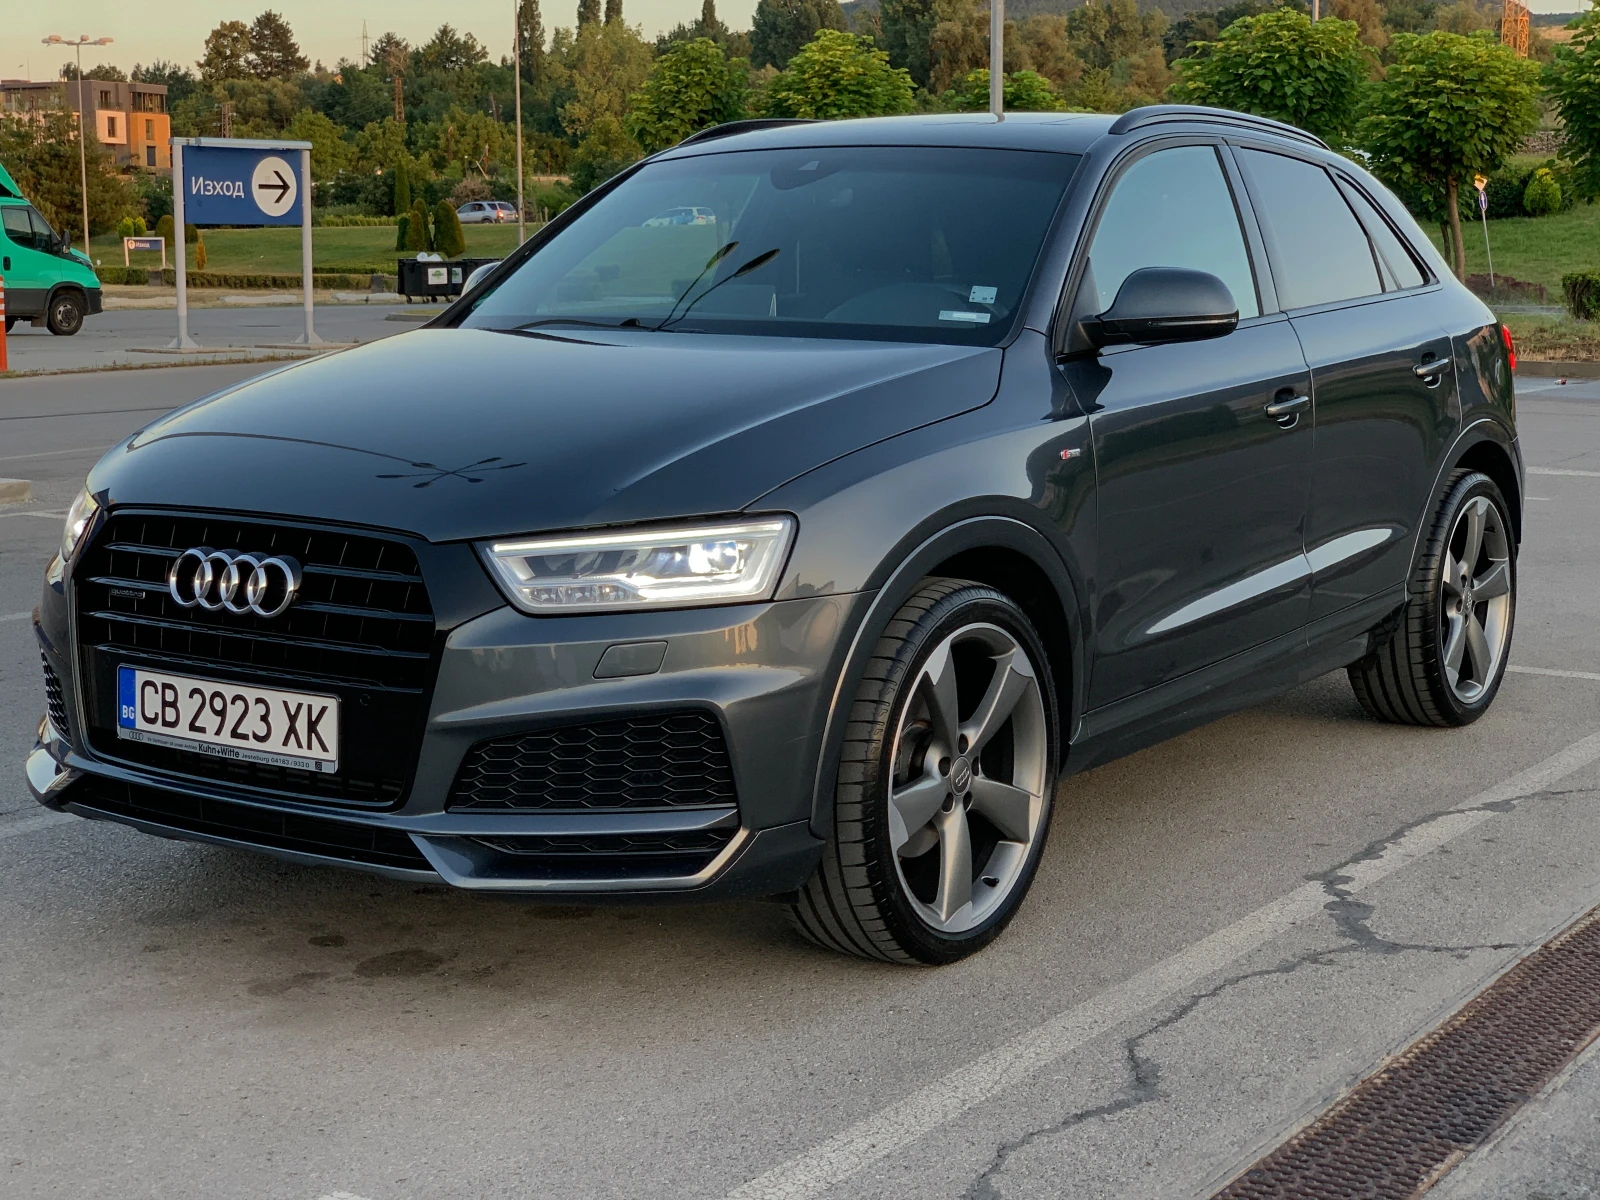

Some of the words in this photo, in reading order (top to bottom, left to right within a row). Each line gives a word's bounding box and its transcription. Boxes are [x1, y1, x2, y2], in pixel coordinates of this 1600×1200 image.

[192, 176, 245, 199] Изход
[122, 705, 135, 719] BG
[140, 679, 181, 729] CB
[188, 687, 273, 744] 2923
[281, 700, 330, 753] XK
[198, 742, 240, 759] Kuhn+Witte
[241, 752, 270, 764] Jesteburg
